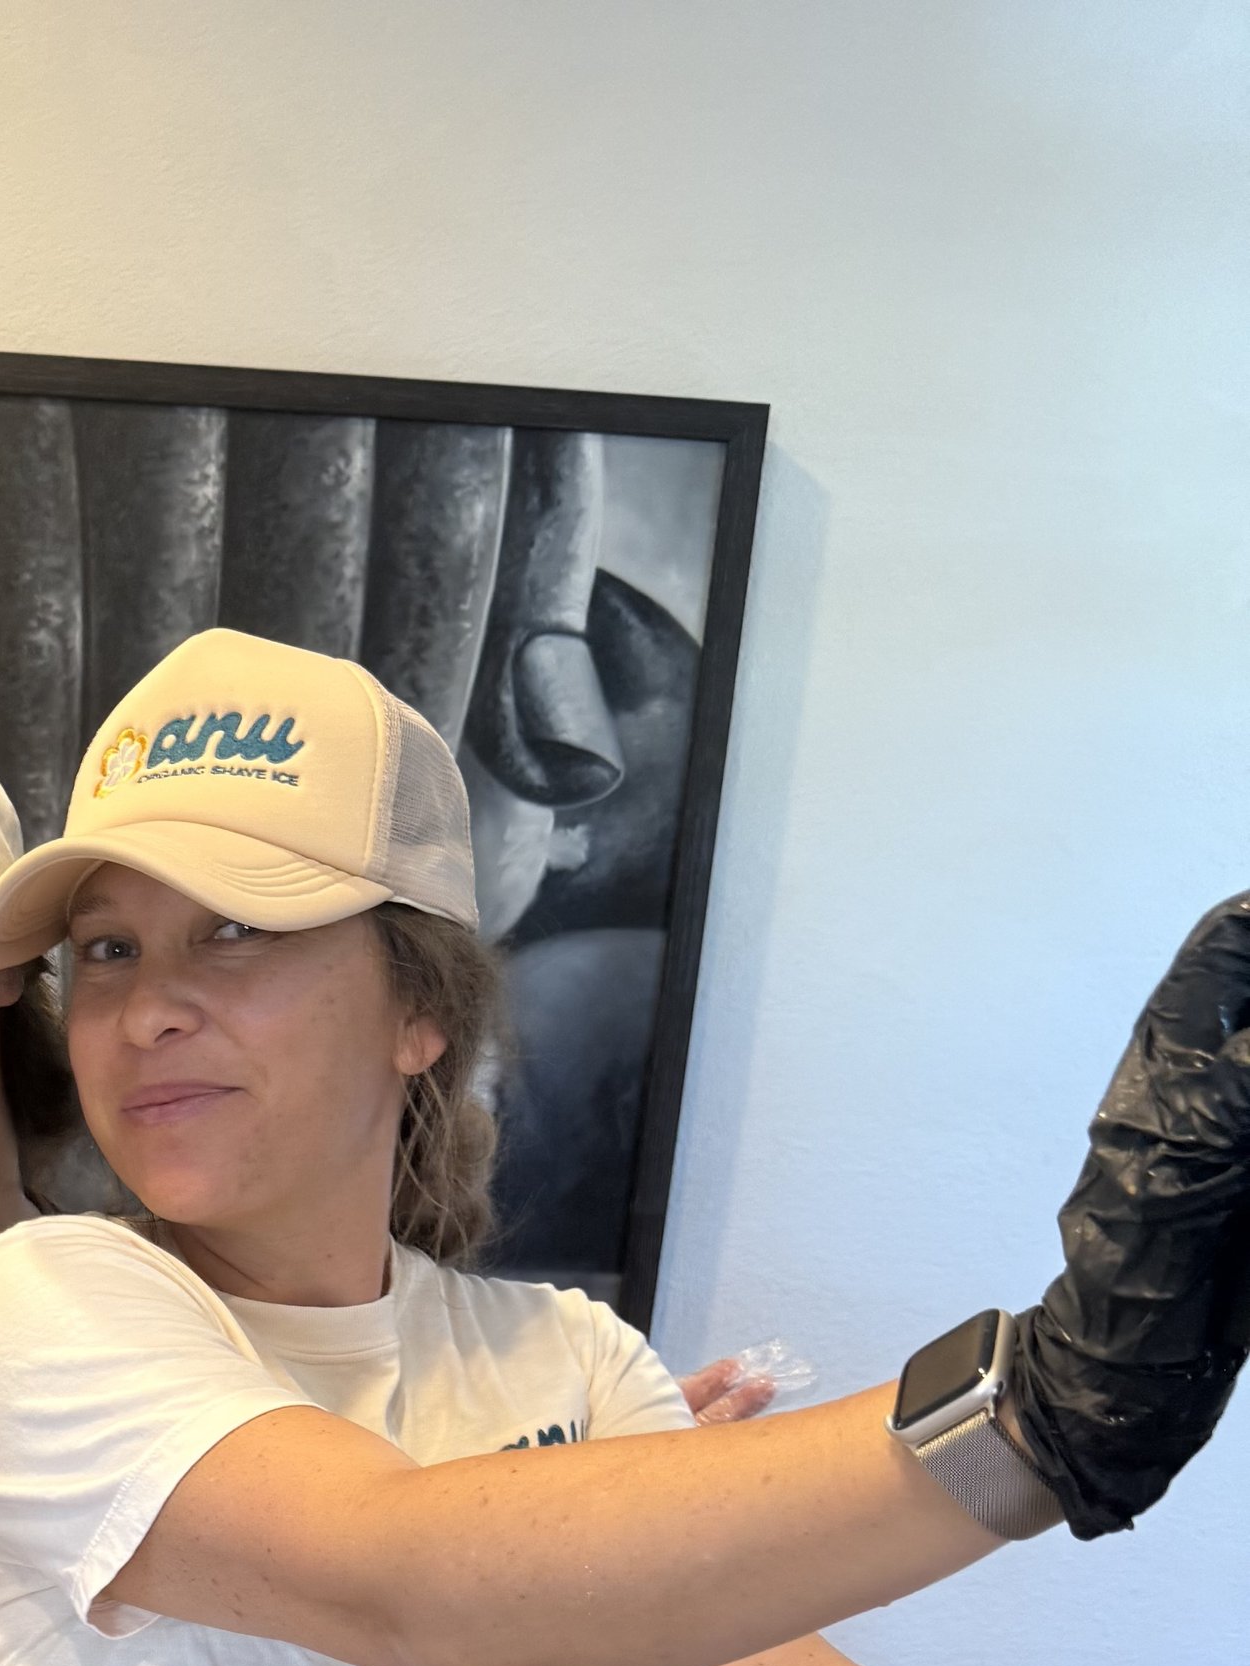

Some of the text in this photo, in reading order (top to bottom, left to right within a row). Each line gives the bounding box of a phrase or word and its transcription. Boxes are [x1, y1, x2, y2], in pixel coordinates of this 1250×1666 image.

[146, 711, 305, 770] anu
[210, 764, 268, 780] SHAVE
[271, 769, 299, 787] ICE
